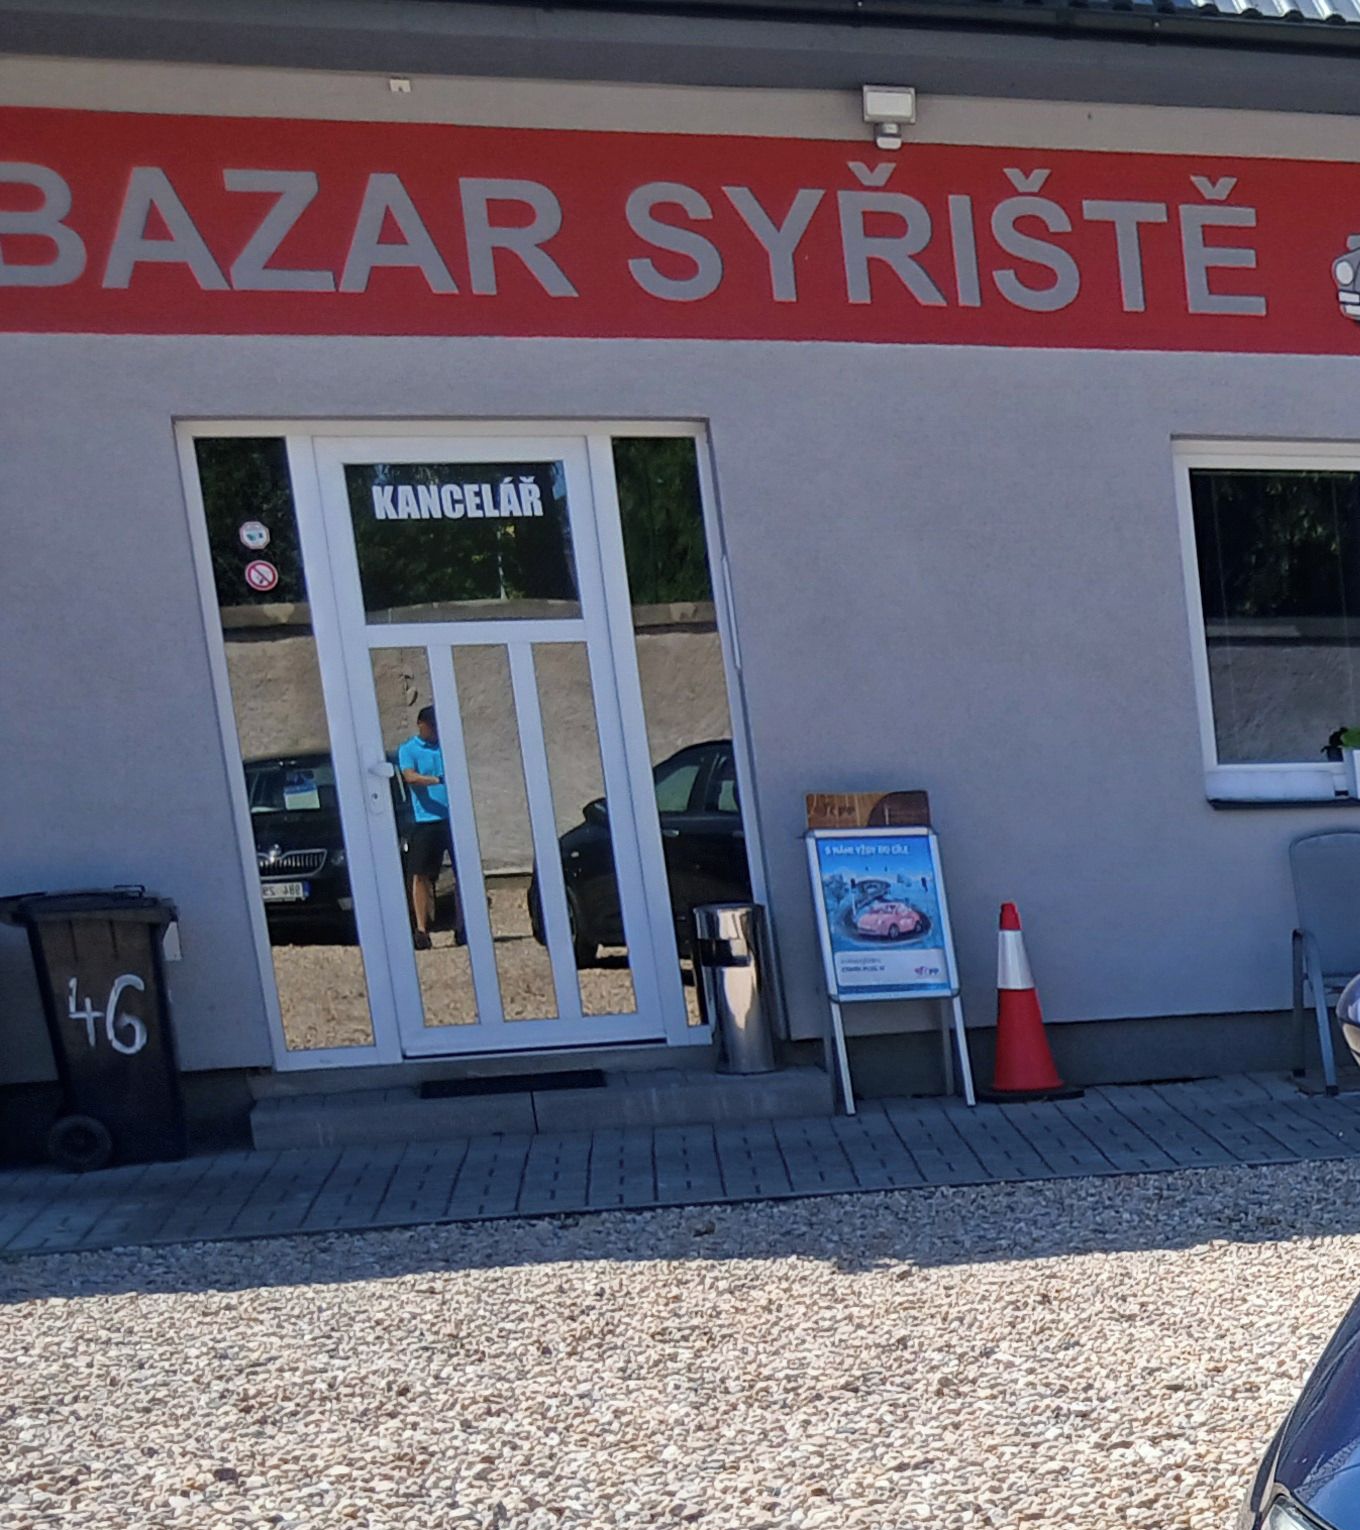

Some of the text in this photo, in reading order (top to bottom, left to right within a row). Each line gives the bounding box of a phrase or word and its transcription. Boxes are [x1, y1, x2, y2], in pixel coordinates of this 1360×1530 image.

[0, 162, 1267, 317] BAZAR SYŘIŠTĚ
[372, 476, 544, 520] KANCELÁŘ
[69, 973, 147, 1054] 46
